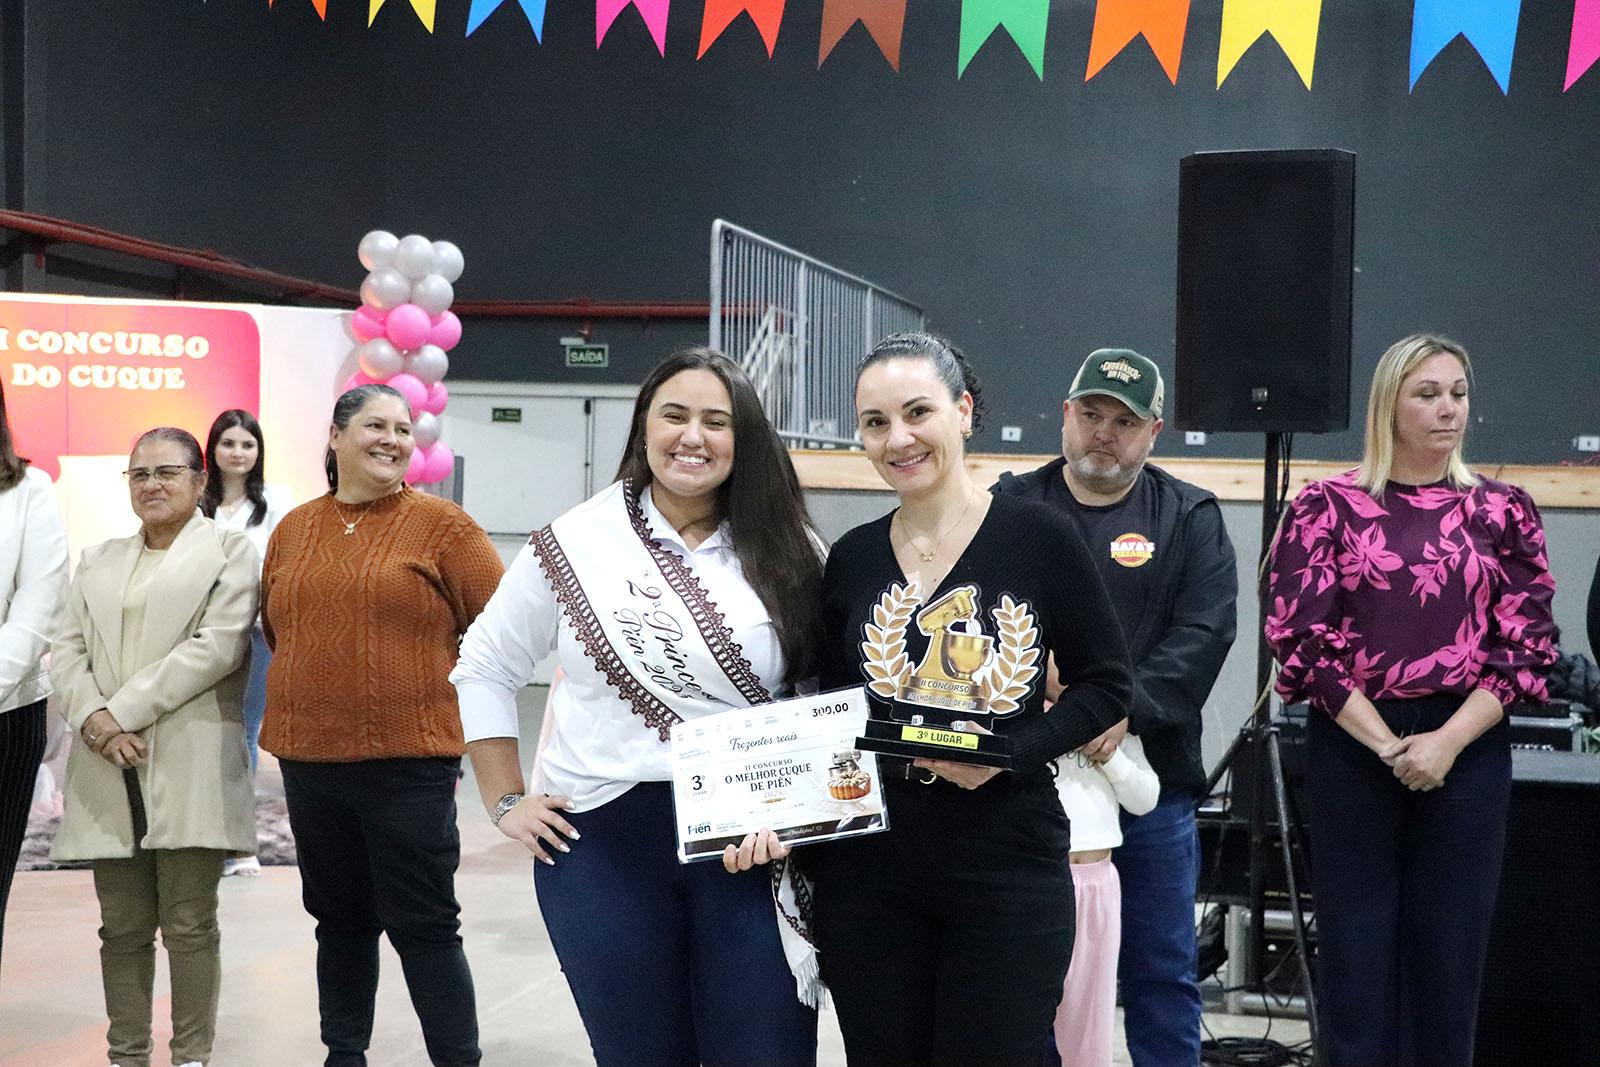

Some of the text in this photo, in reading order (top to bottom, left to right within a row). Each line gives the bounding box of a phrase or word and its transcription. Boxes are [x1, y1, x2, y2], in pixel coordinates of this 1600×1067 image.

[16, 329, 210, 359] CONCURSO
[570, 350, 603, 363] SAÍDA
[11, 363, 186, 390] DO CUQUE
[927, 681, 969, 693] CONCURSO
[729, 732, 798, 753] Trezentos reais
[917, 730, 962, 744] 3º LUGAR
[752, 758, 793, 770] CONCURSO
[724, 762, 813, 785] O MELHOR CUQUE
[750, 776, 793, 792] DE PIÊN
